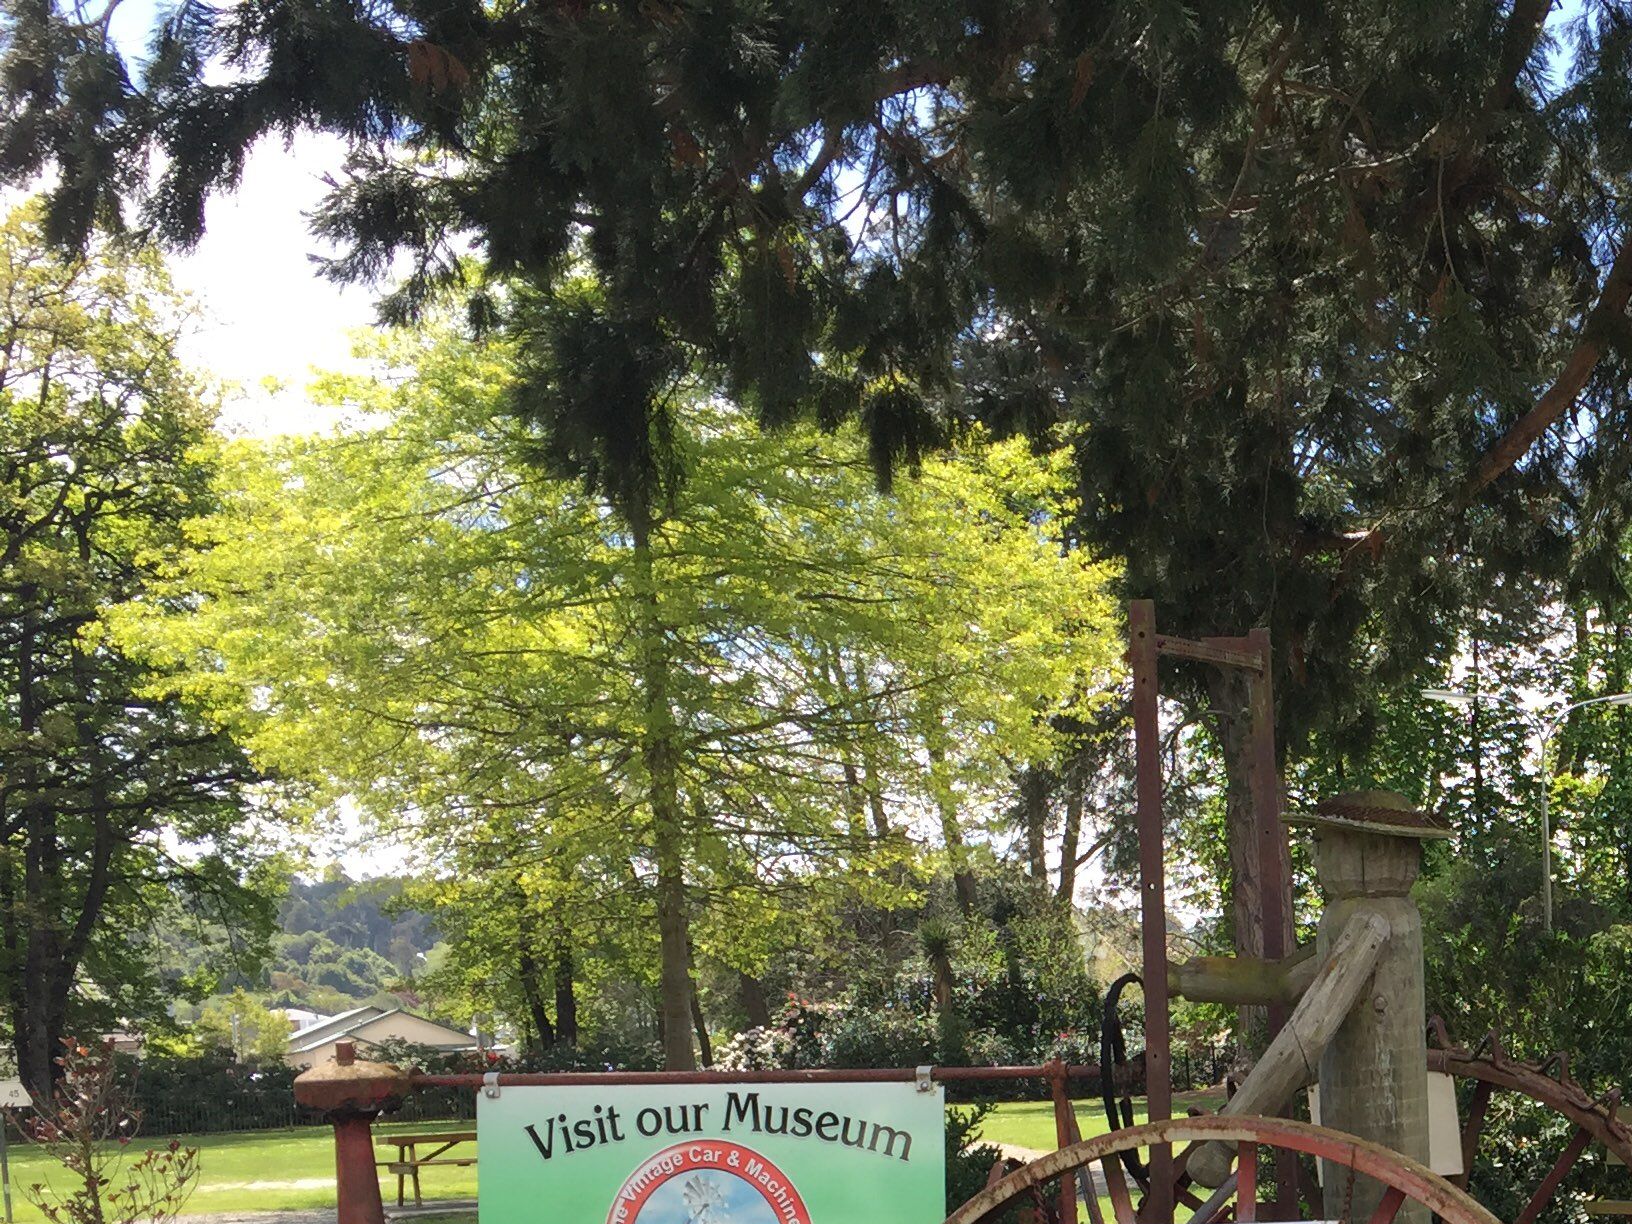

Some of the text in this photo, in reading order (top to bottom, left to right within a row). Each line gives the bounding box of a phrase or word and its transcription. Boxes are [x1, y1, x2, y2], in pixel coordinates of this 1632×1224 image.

[525, 1091, 914, 1162] Visit our Museum
[621, 1151, 684, 1202] Vintage
[688, 1145, 723, 1163] Car
[726, 1150, 741, 1168] &
